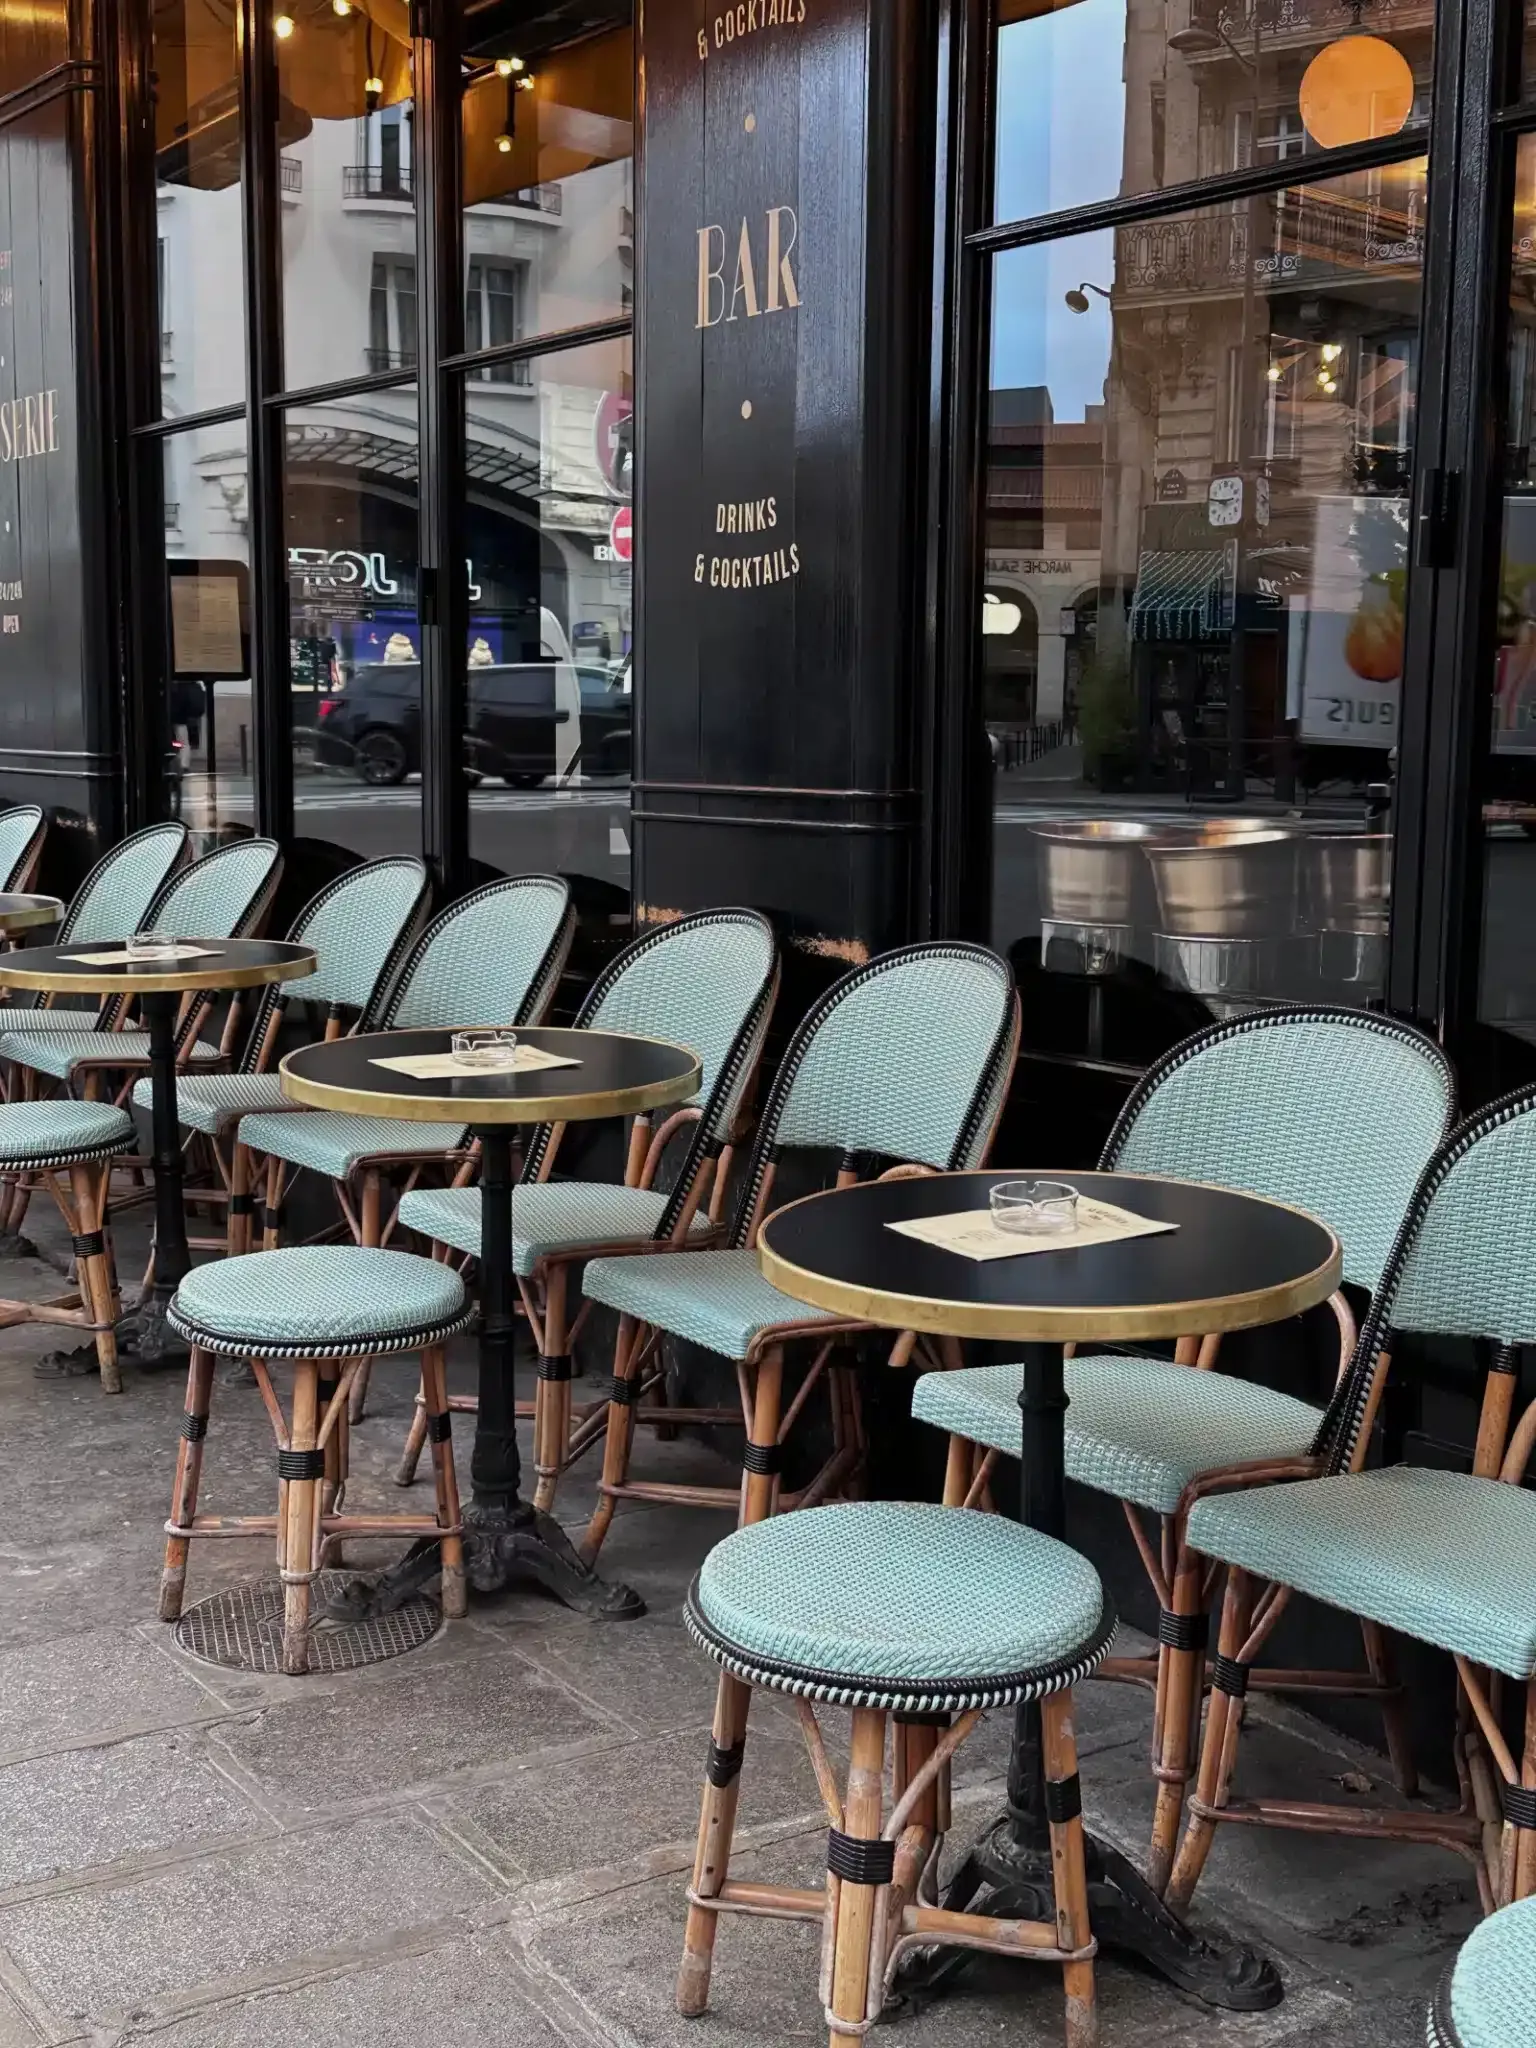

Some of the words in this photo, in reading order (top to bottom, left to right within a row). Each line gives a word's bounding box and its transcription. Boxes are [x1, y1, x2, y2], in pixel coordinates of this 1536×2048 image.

[697, 28, 709, 60] &
[714, 0, 806, 49] COCKTAILS
[694, 205, 804, 330] BAR
[0, 389, 60, 463] SERIE
[715, 496, 778, 534] DRINKS
[694, 552, 705, 584] &
[709, 542, 801, 589] COCKTAILS
